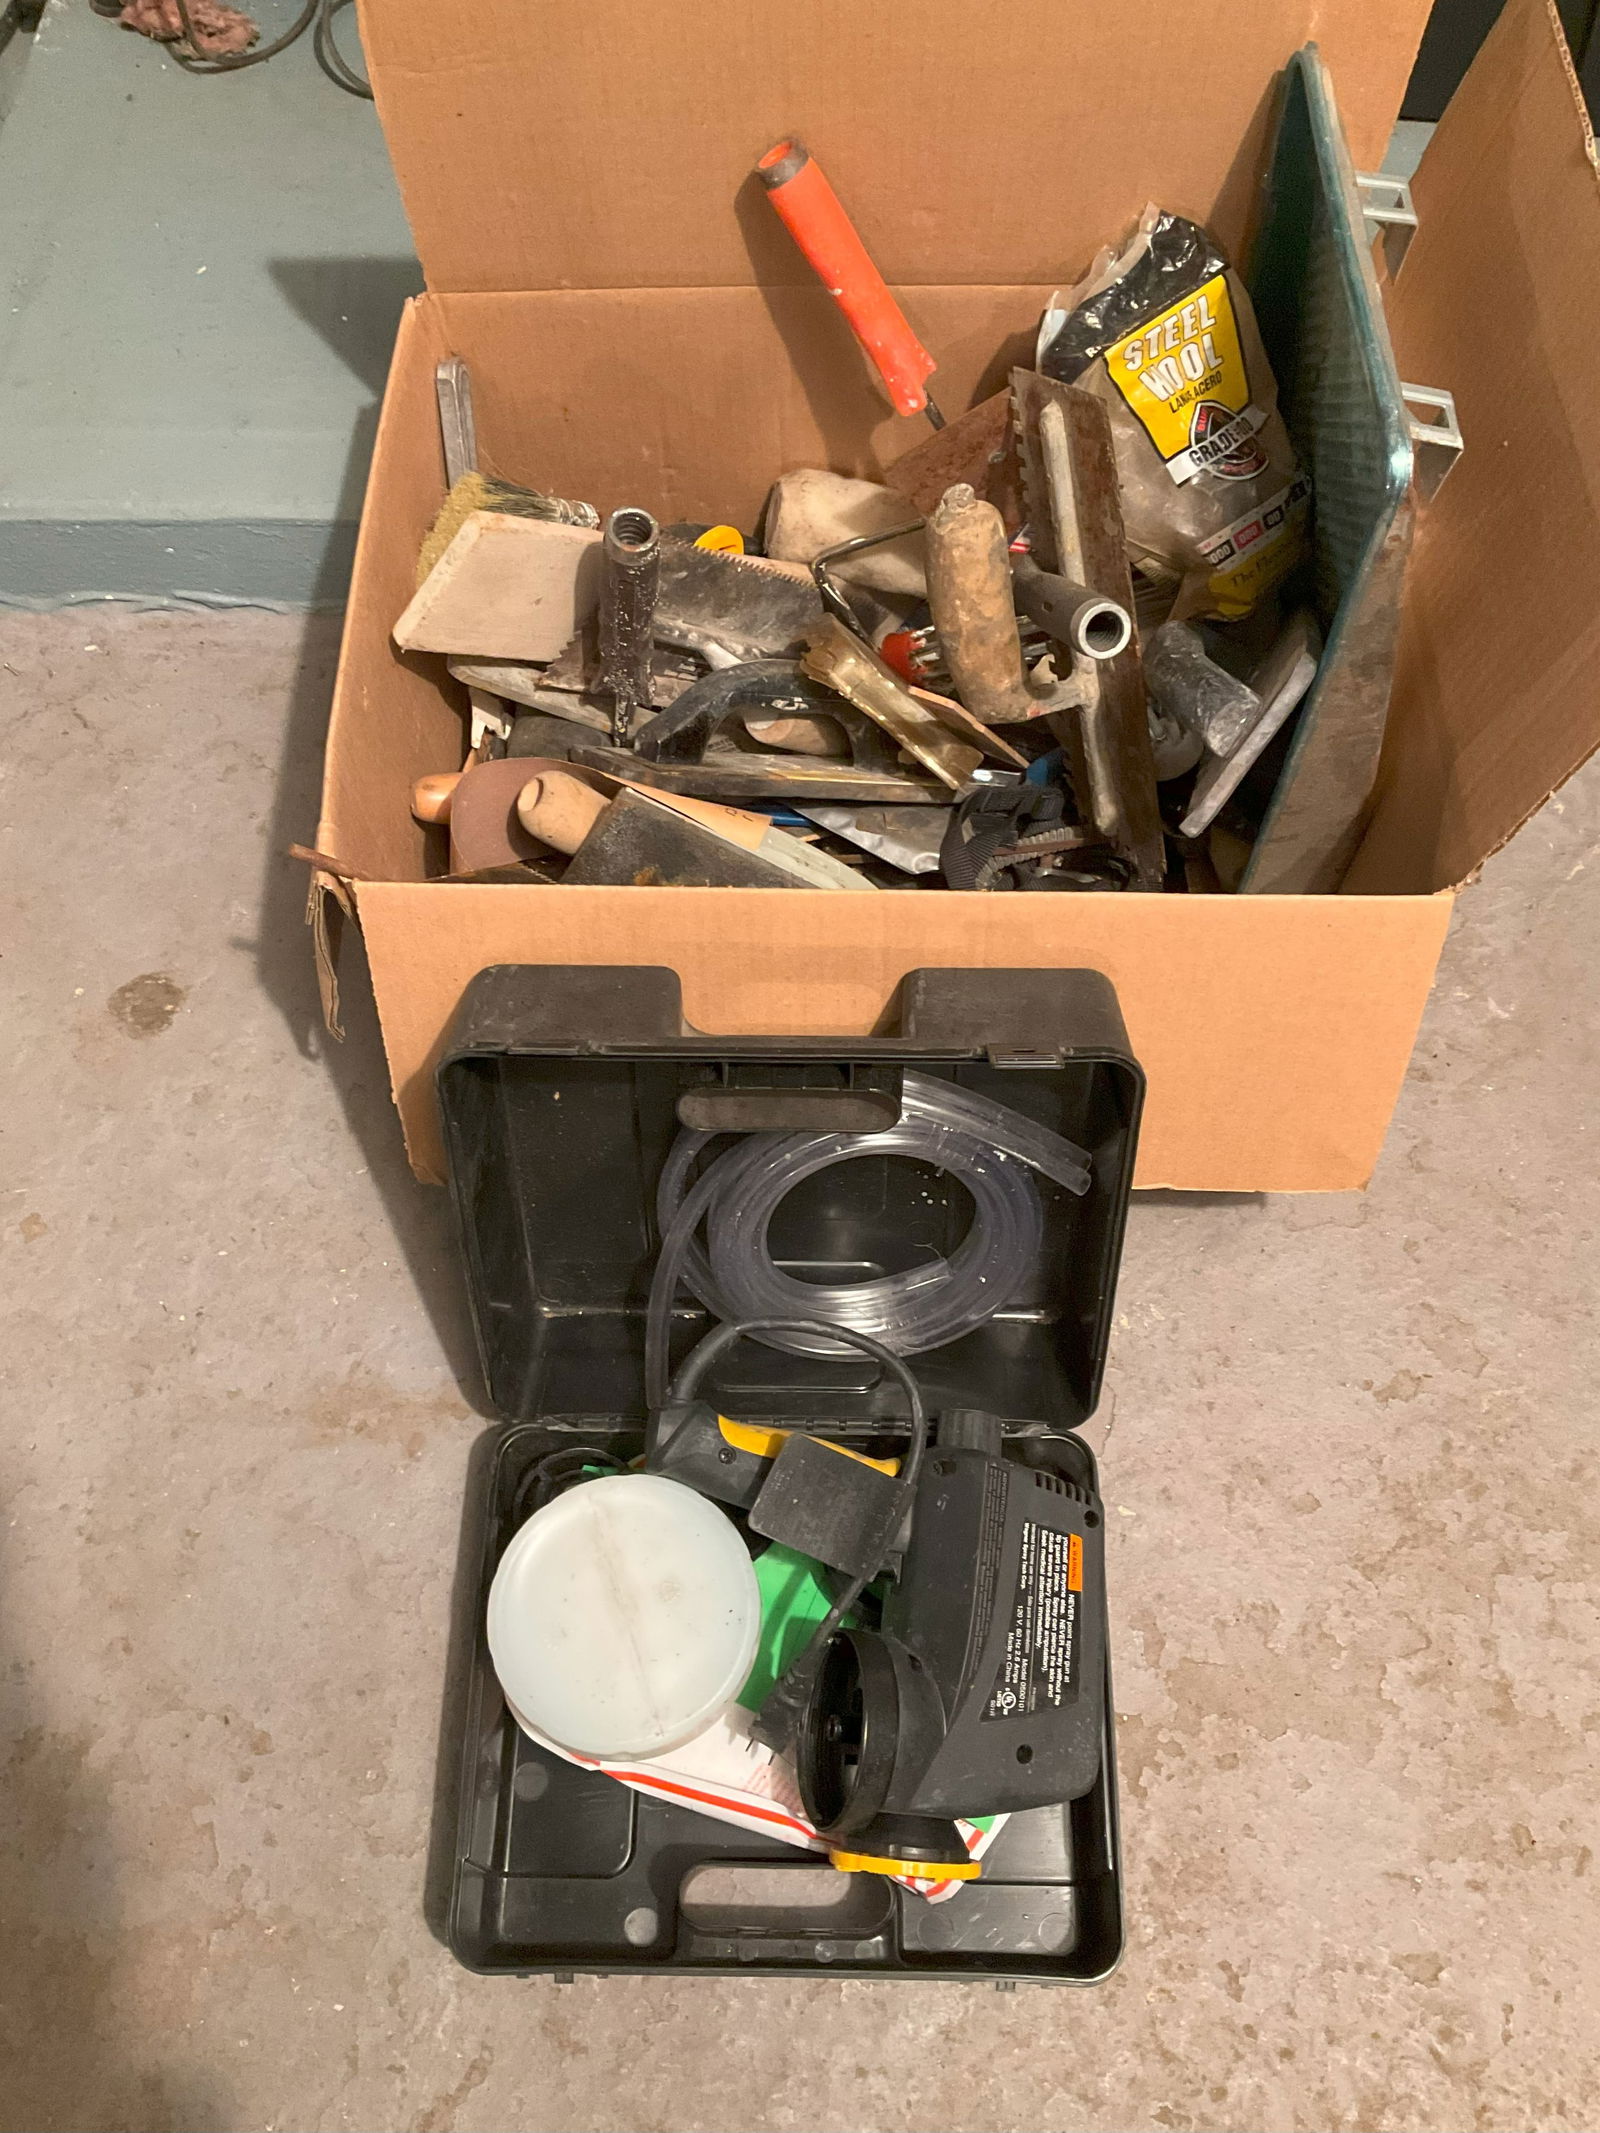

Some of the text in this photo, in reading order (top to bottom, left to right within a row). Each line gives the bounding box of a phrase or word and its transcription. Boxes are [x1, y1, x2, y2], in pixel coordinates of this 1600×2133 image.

[1123, 294, 1216, 370] STEEL
[1138, 333, 1224, 401] WOOL
[1194, 370, 1222, 397] ACERO
[1189, 428, 1239, 467] GRADE
[1062, 1564, 1067, 1572] or
[1016, 1628, 1022, 1637] 60
[1035, 1606, 1044, 1649] immediately.
[1015, 1639, 1021, 1649] Hz
[1041, 1630, 1050, 1672] amputation).
[1056, 1647, 1064, 1666] spray
[1005, 1662, 1013, 1682] China
[1012, 1663, 1020, 1683] Amps
[1021, 1659, 1029, 1680] Model
